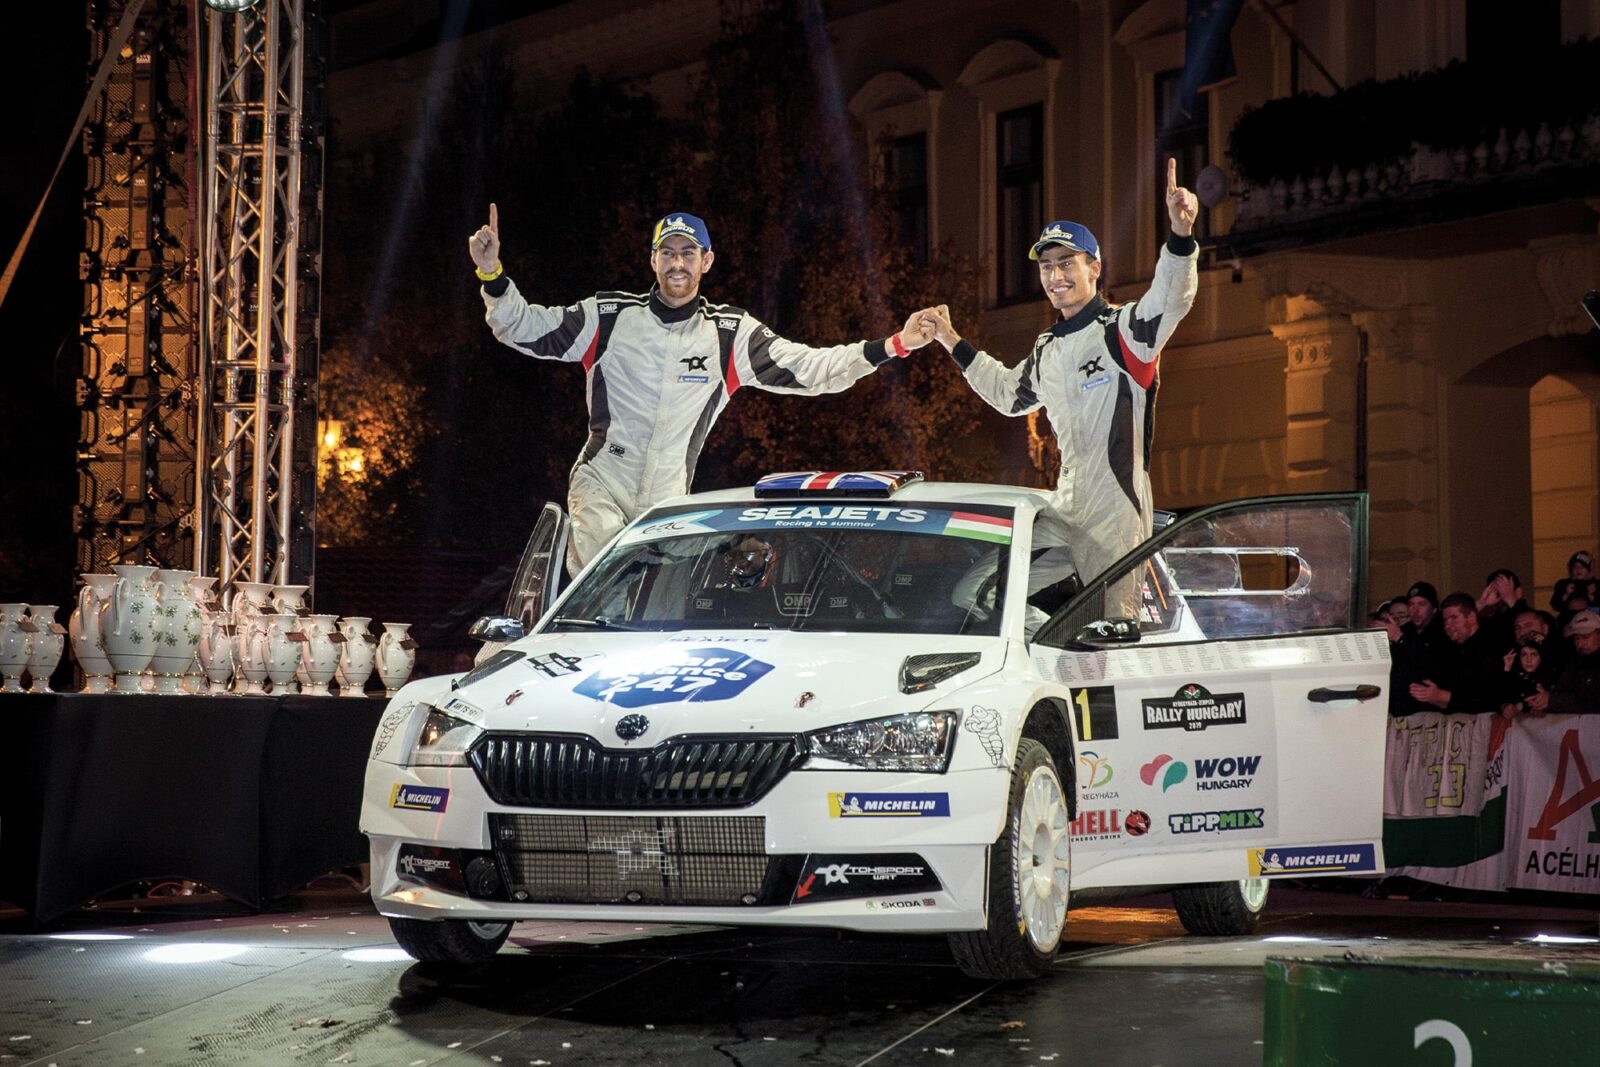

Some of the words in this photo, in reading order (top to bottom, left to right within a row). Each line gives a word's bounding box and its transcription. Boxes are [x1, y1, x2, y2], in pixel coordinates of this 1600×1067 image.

[600, 303, 618, 314] OMP
[719, 319, 737, 329] OMP
[738, 506, 928, 523] SEAJETS
[775, 520, 813, 528] Racing
[895, 575, 913, 584] OMP
[695, 599, 713, 608] OMP
[784, 596, 812, 607] OMP
[830, 598, 848, 607] OMP
[598, 674, 717, 697] 247
[1075, 688, 1093, 741] 1
[1146, 705, 1184, 724] RALLY
[1186, 700, 1243, 721] HUNGARY
[1188, 722, 1202, 730] 2019
[1195, 756, 1262, 779] WOW
[1196, 778, 1253, 791] HUNGARY
[406, 793, 442, 806] MICHELIN
[864, 800, 936, 811] MICHELIN
[1071, 808, 1122, 837] HELL
[1071, 835, 1098, 843] ENERGY
[1011, 816, 1022, 907] MICHELIN
[1284, 853, 1361, 867] MICHELIN
[1525, 847, 1600, 879] ACÉLH
[848, 866, 924, 875] TOKSPORT
[873, 873, 897, 881] WRT
